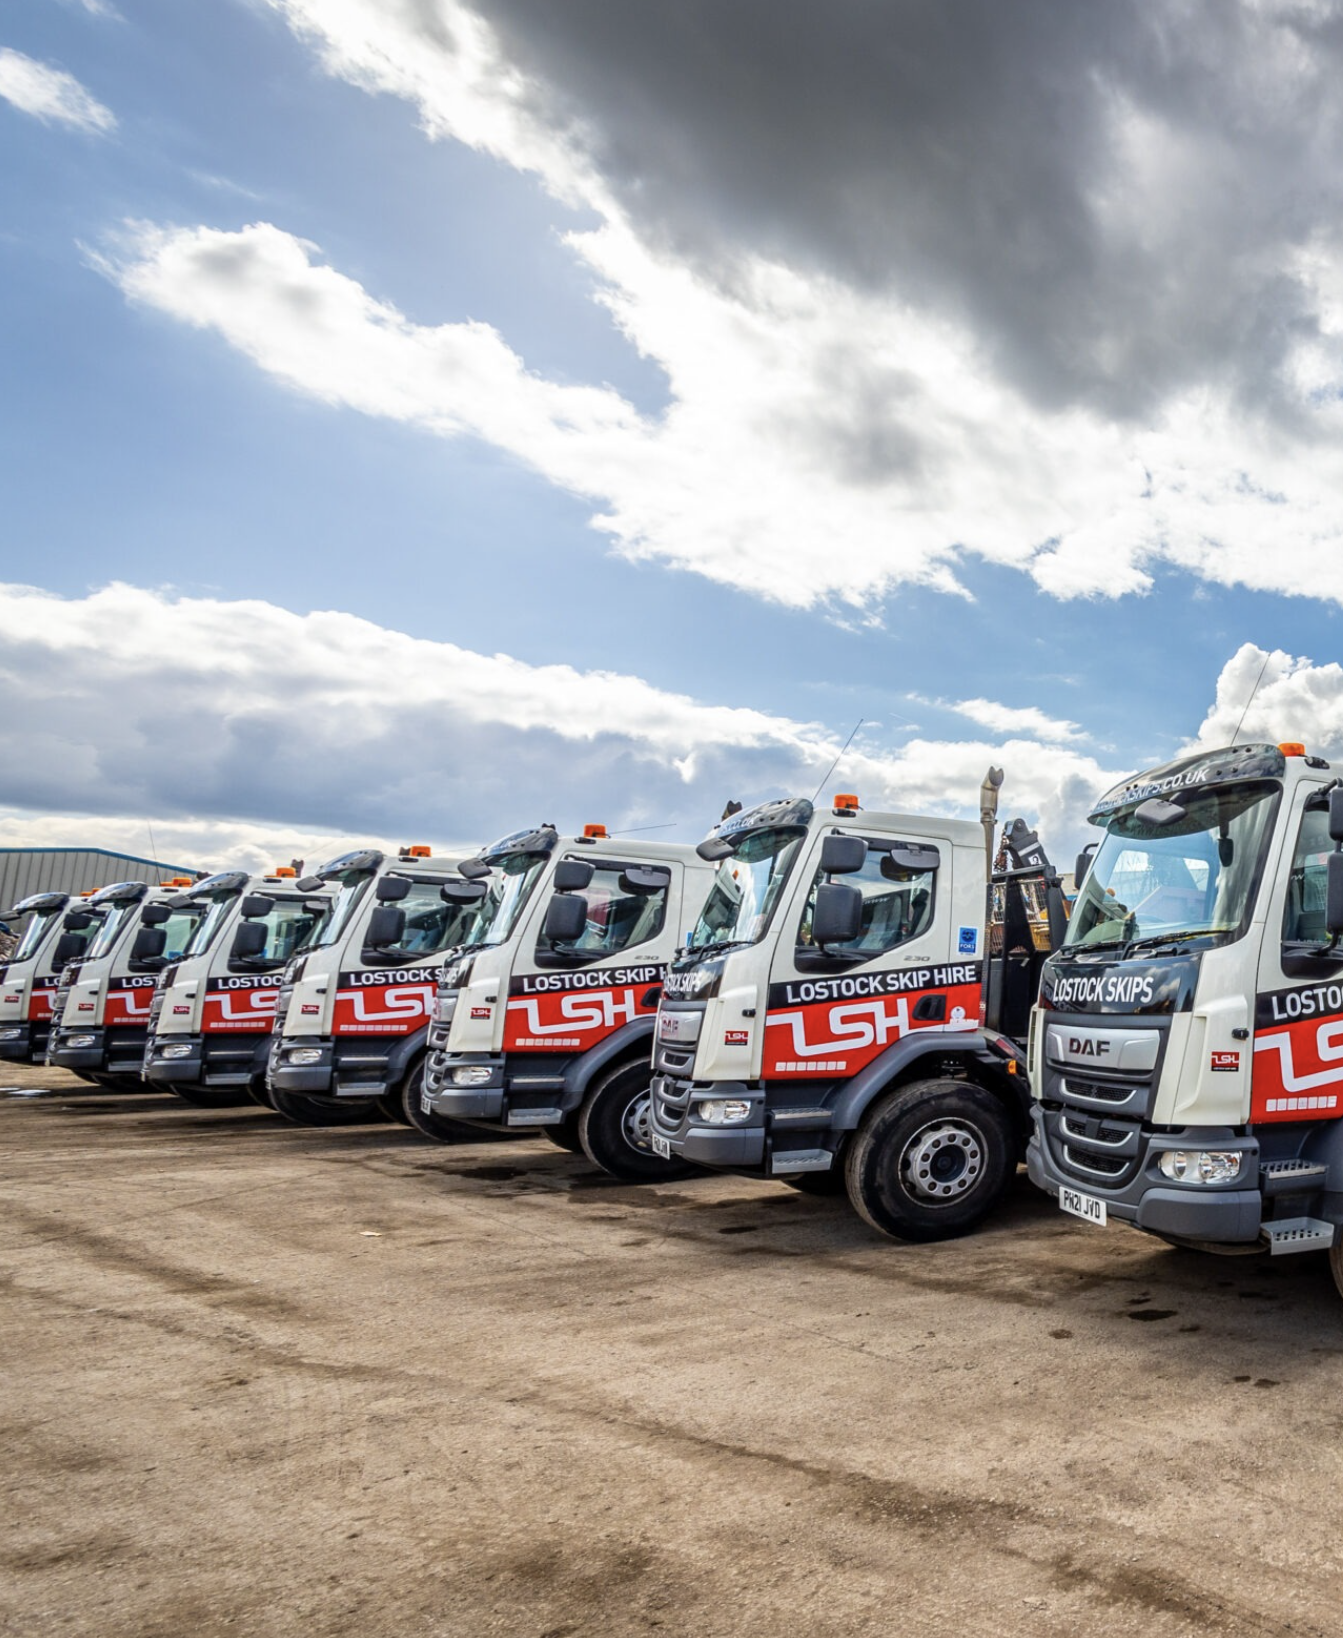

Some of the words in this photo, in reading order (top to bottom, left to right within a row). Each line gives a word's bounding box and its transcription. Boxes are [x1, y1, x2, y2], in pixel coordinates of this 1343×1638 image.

[350, 968, 433, 986] LOSTOCK
[523, 970, 613, 993] LOSTOCK
[614, 968, 654, 984] SKIP
[786, 974, 885, 1004] LOSTOCK
[886, 969, 931, 991] SKIP
[934, 964, 977, 986] HIRE
[1053, 976, 1107, 1002] LOSTOCK
[1106, 976, 1154, 1003] SKIPS
[1069, 1037, 1111, 1056] DAF
[1063, 1190, 1082, 1213] PN21
[1083, 1198, 1101, 1219] JVD
